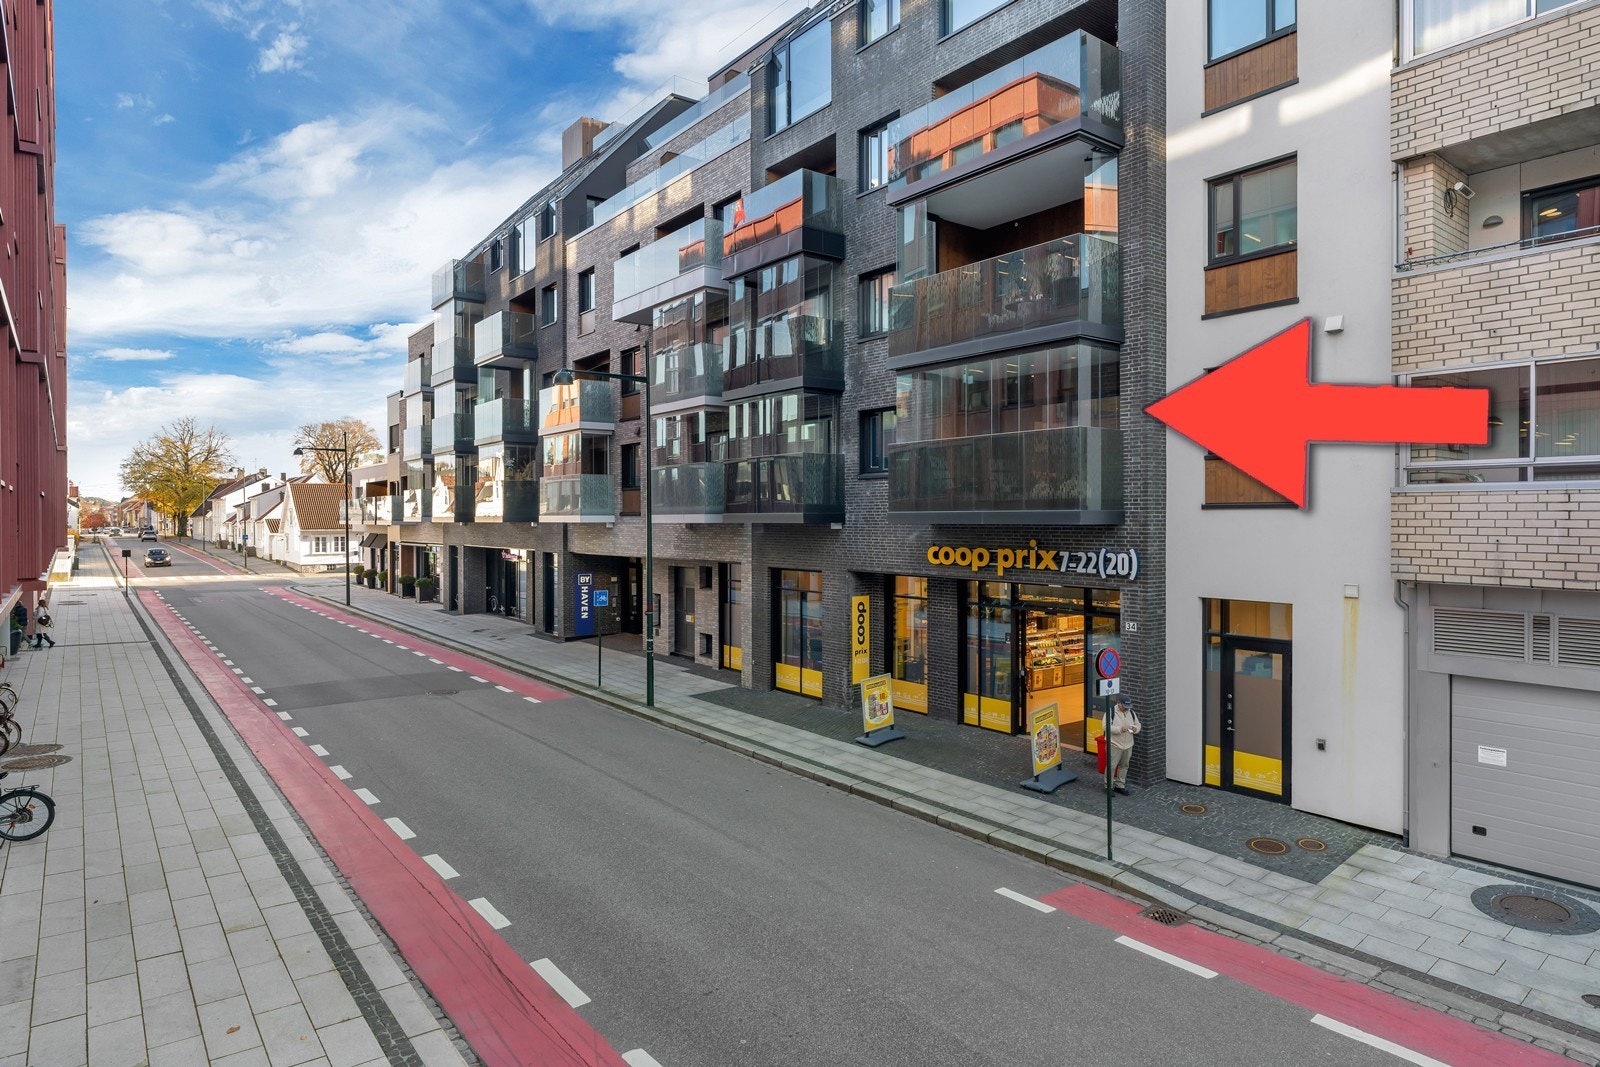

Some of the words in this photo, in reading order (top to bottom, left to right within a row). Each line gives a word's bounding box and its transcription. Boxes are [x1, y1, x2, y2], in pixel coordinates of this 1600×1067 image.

[926, 545, 990, 572] coop
[997, 539, 1059, 577] prix
[1059, 548, 1138, 580] 7-22(20)
[581, 586, 589, 619] HAVEN
[857, 601, 867, 645] coop
[854, 648, 867, 657] prix
